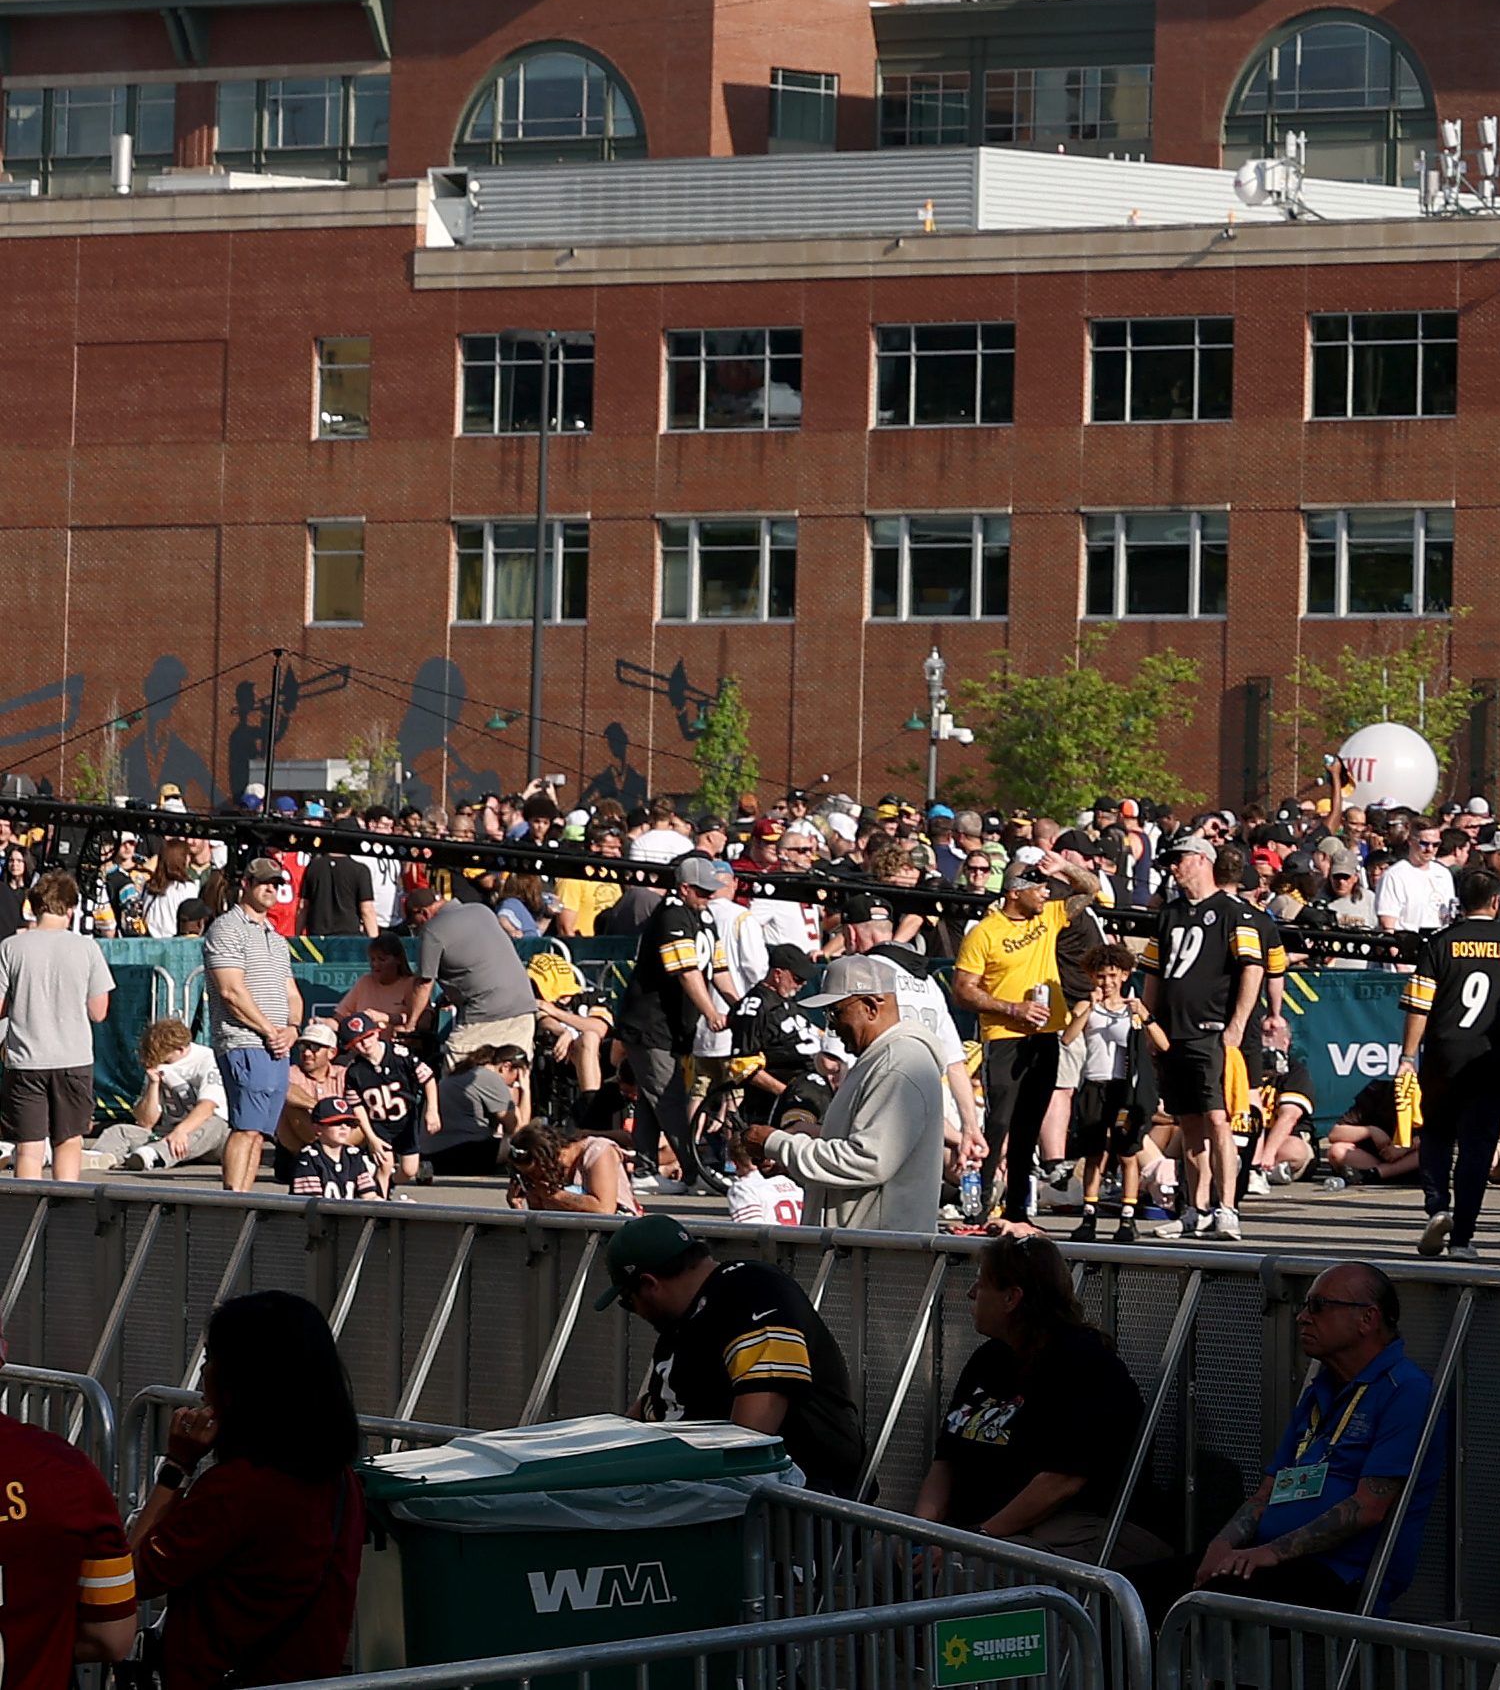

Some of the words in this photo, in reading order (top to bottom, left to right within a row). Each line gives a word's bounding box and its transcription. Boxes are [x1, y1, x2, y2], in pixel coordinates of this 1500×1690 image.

[1001, 920, 1048, 954] Steelers
[1163, 925, 1203, 979] 19
[1458, 970, 1491, 1028] 9
[361, 1082, 406, 1122] 85
[527, 1561, 668, 1614] WM
[972, 1633, 1041, 1657] SUNBELT
[981, 1650, 1033, 1662] RENTALS
